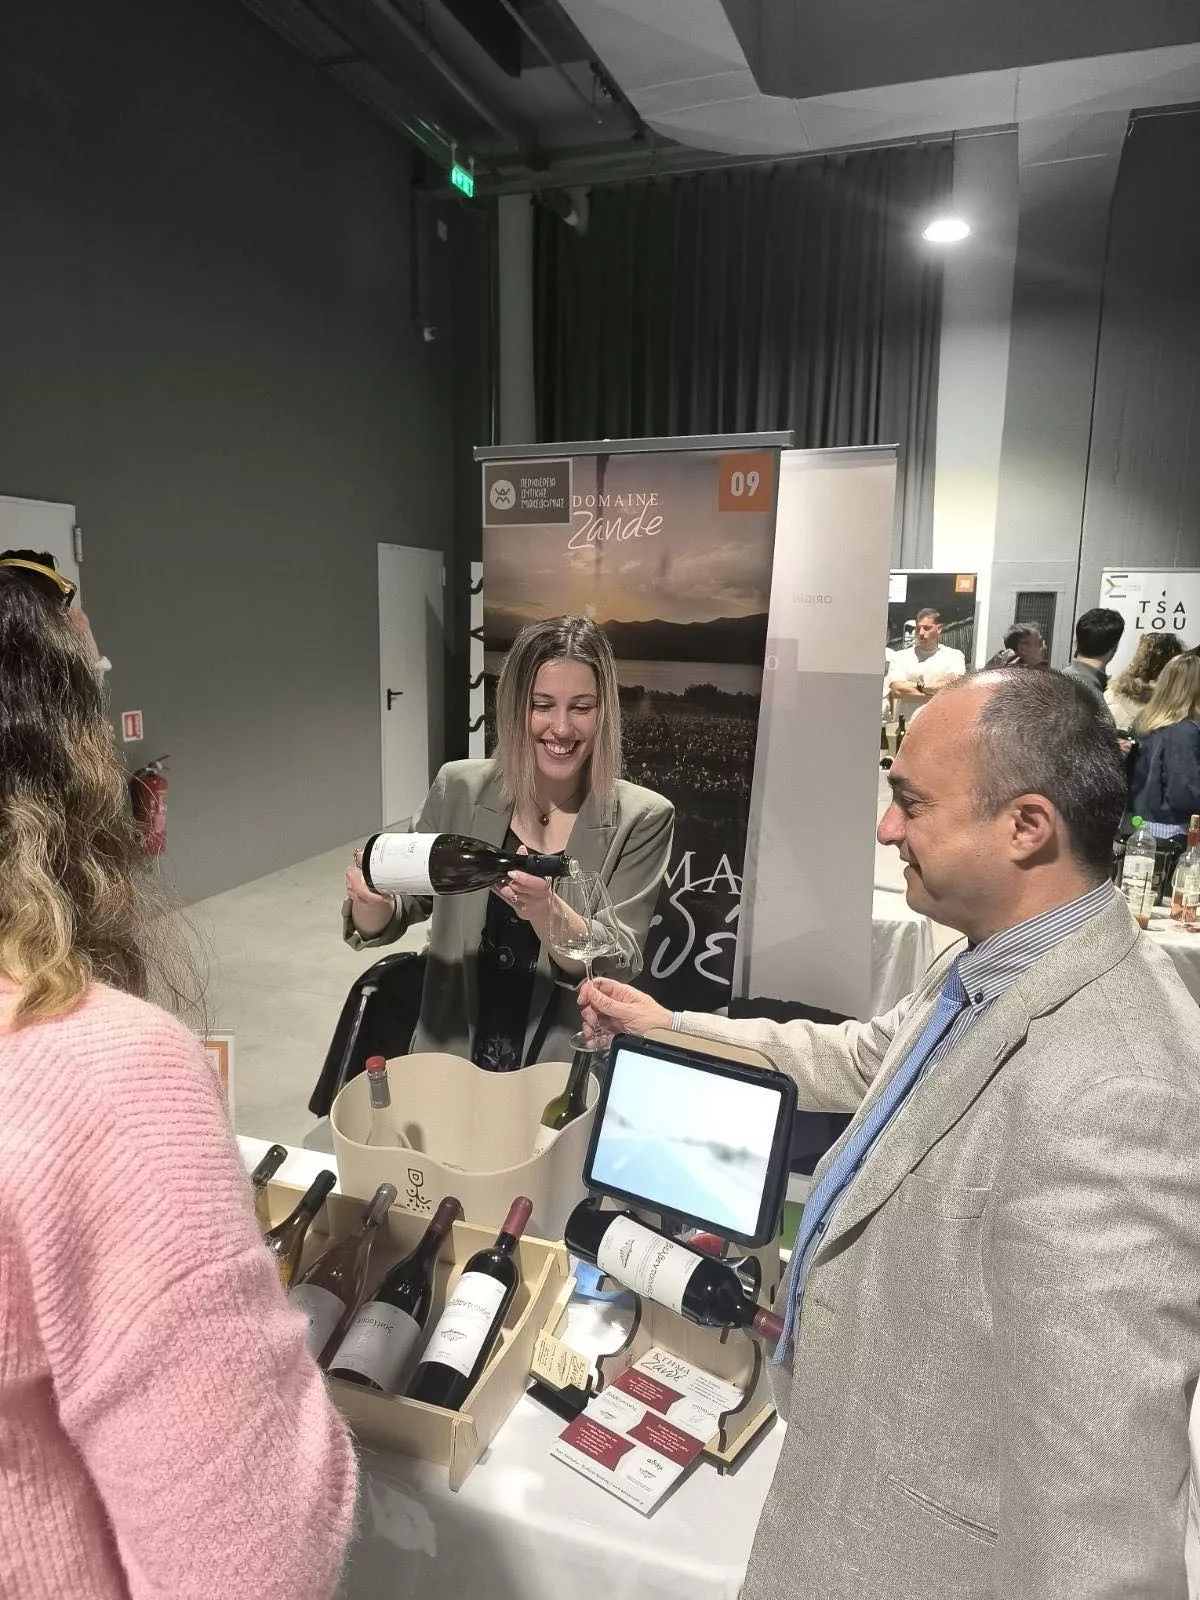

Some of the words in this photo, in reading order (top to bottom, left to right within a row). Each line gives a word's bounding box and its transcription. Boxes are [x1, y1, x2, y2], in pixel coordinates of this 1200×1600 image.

[731, 471, 760, 497] 09
[573, 493, 659, 508] DOMAINE
[568, 497, 663, 550] Zande
[1136, 616, 1186, 631] LOU
